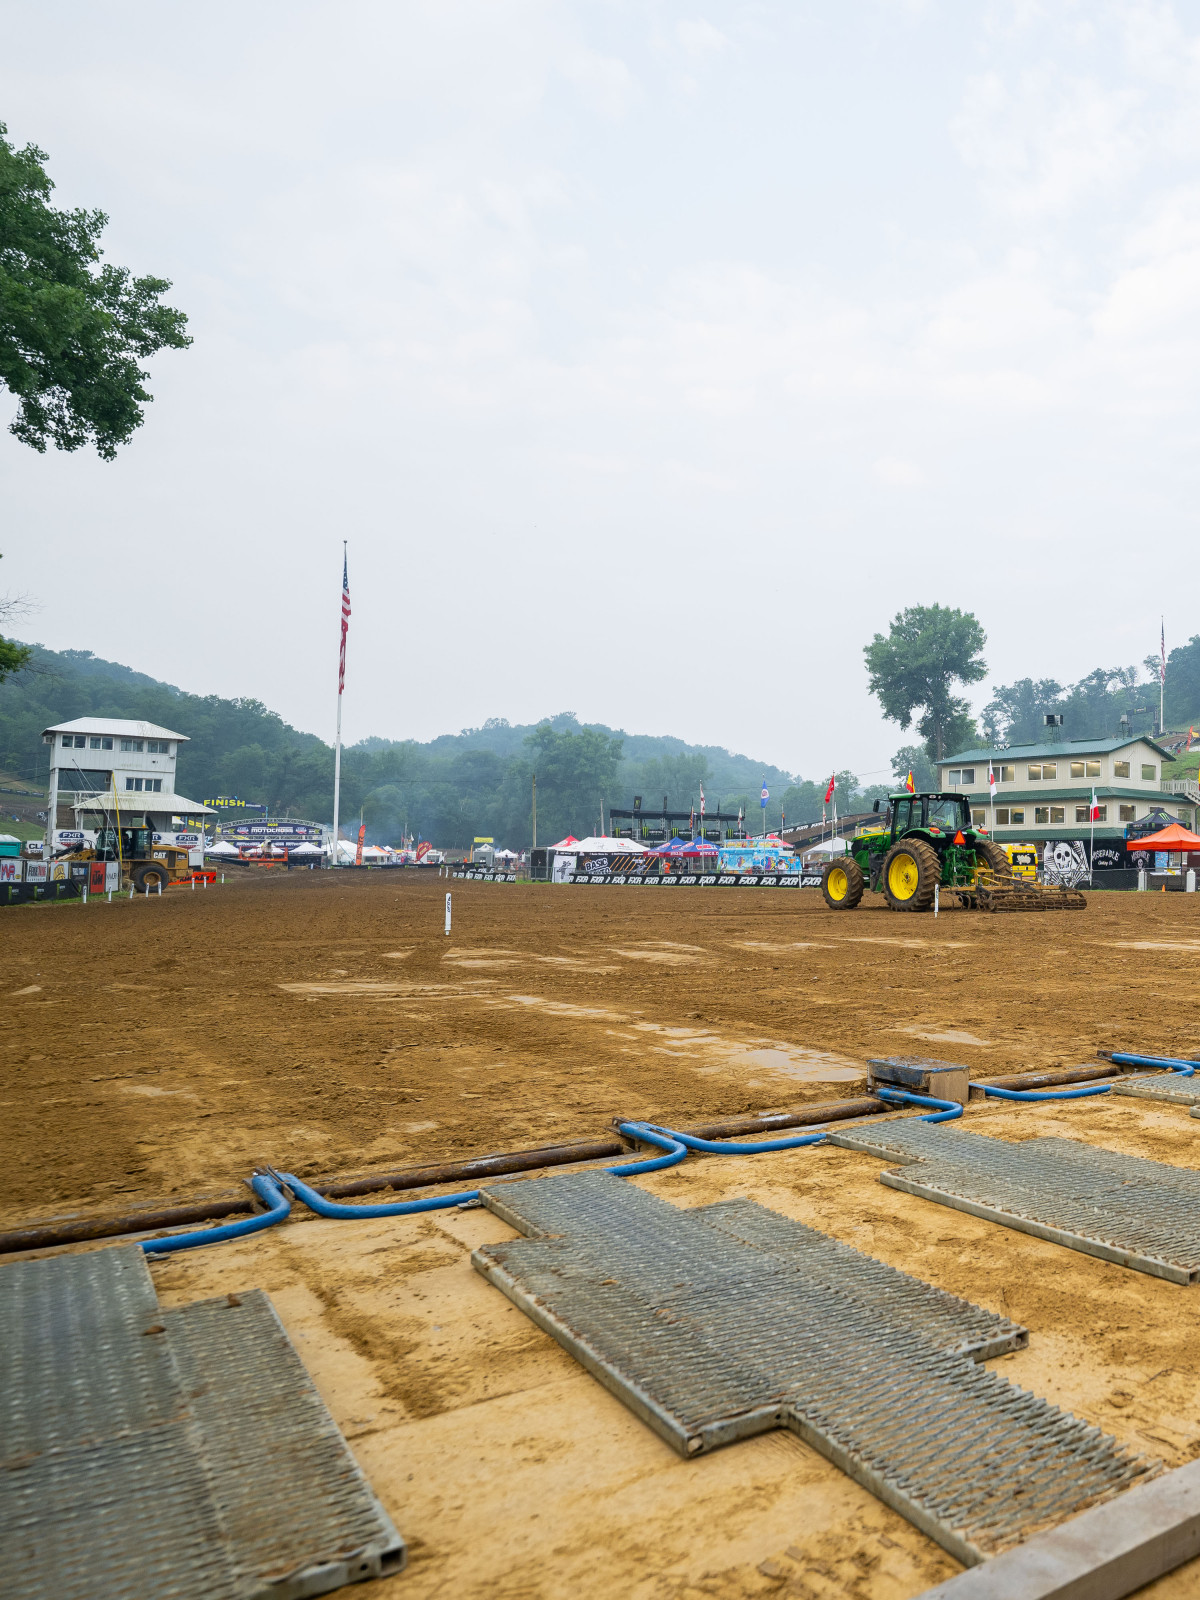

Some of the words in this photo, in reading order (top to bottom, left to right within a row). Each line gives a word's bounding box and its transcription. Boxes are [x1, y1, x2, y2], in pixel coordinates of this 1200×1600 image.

[203, 799, 245, 808] FINISH
[585, 857, 608, 871] BASIC
[628, 876, 642, 884] FXR
[644, 876, 660, 885] FXR
[661, 876, 677, 884] FXR
[679, 876, 697, 884] FXR
[718, 876, 736, 885] FXR
[738, 876, 758, 885] FXR
[779, 876, 799, 885] FXR
[801, 876, 822, 885] FXR
